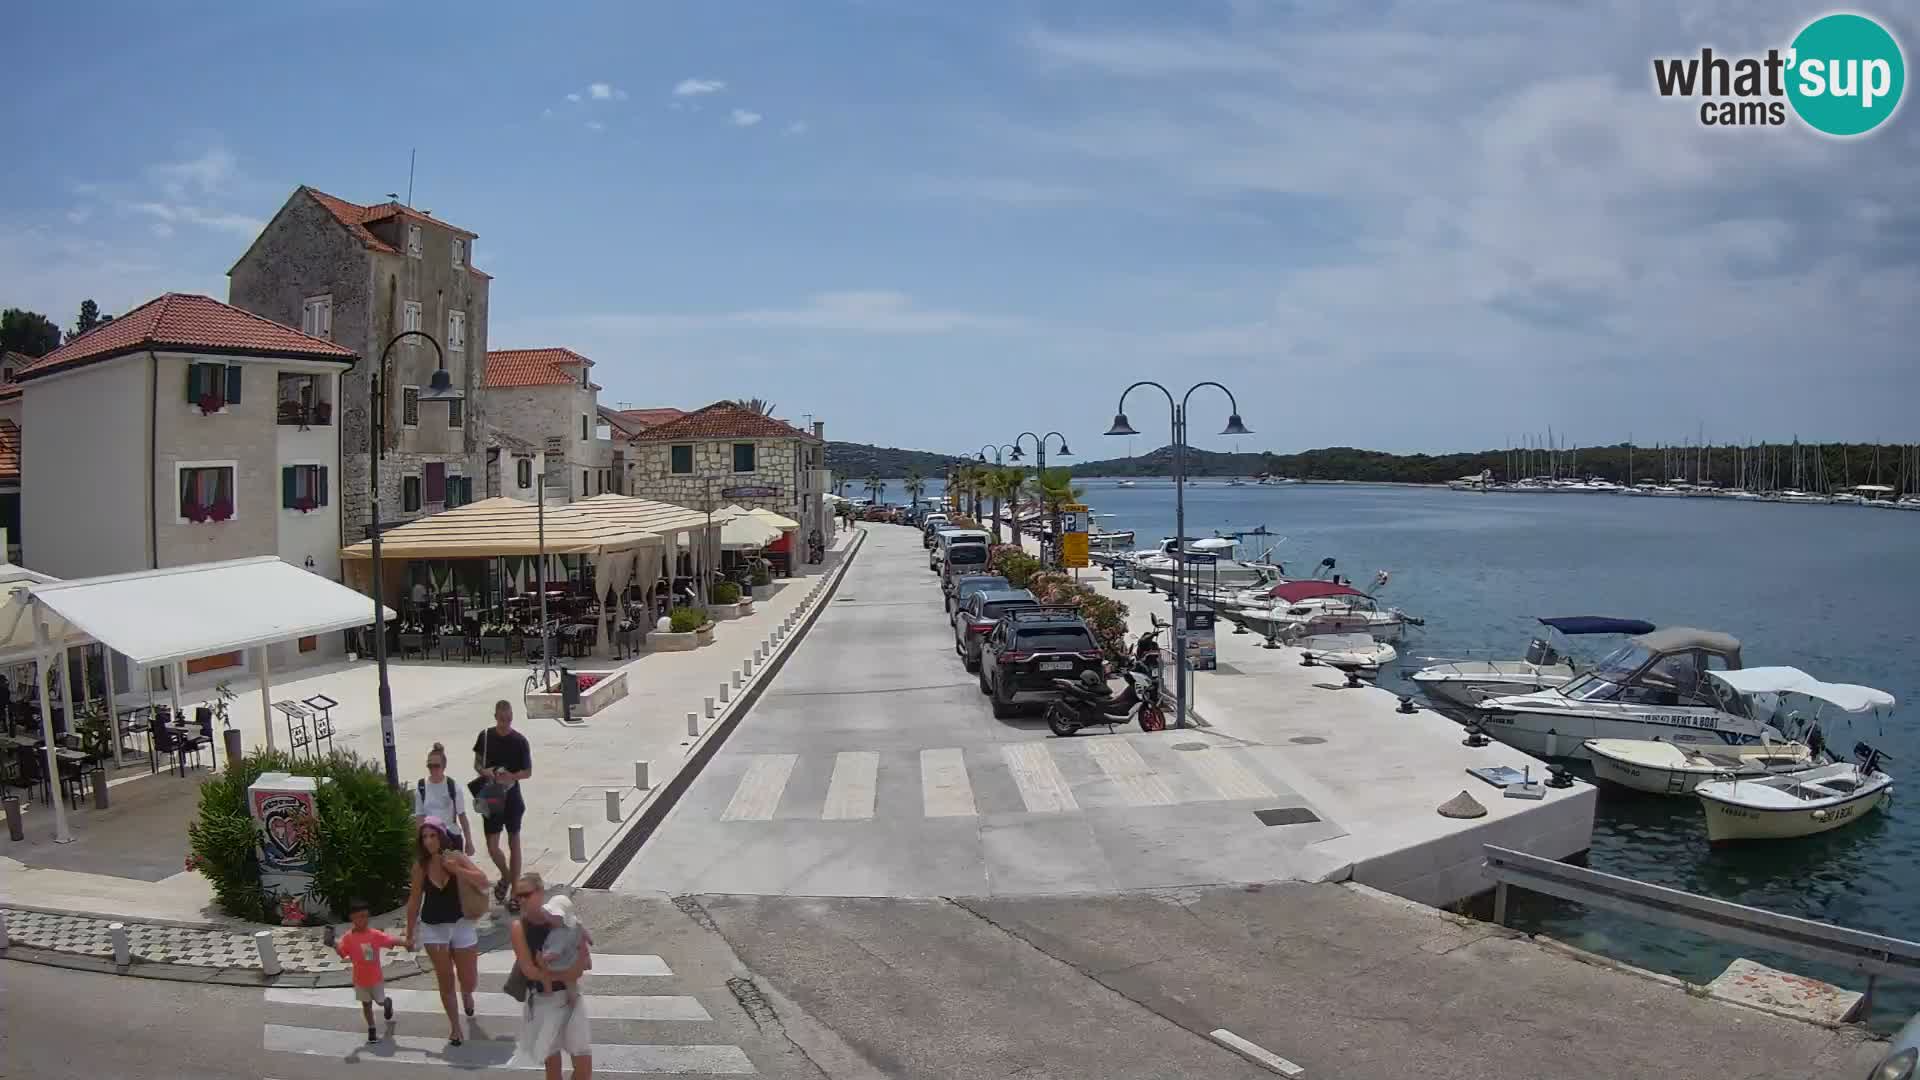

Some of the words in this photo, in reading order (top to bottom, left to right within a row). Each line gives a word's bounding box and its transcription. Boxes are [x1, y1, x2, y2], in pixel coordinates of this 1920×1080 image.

[1065, 514, 1075, 530] P
[1670, 715, 1691, 726] RENT
[1699, 716, 1720, 729] BOAT
